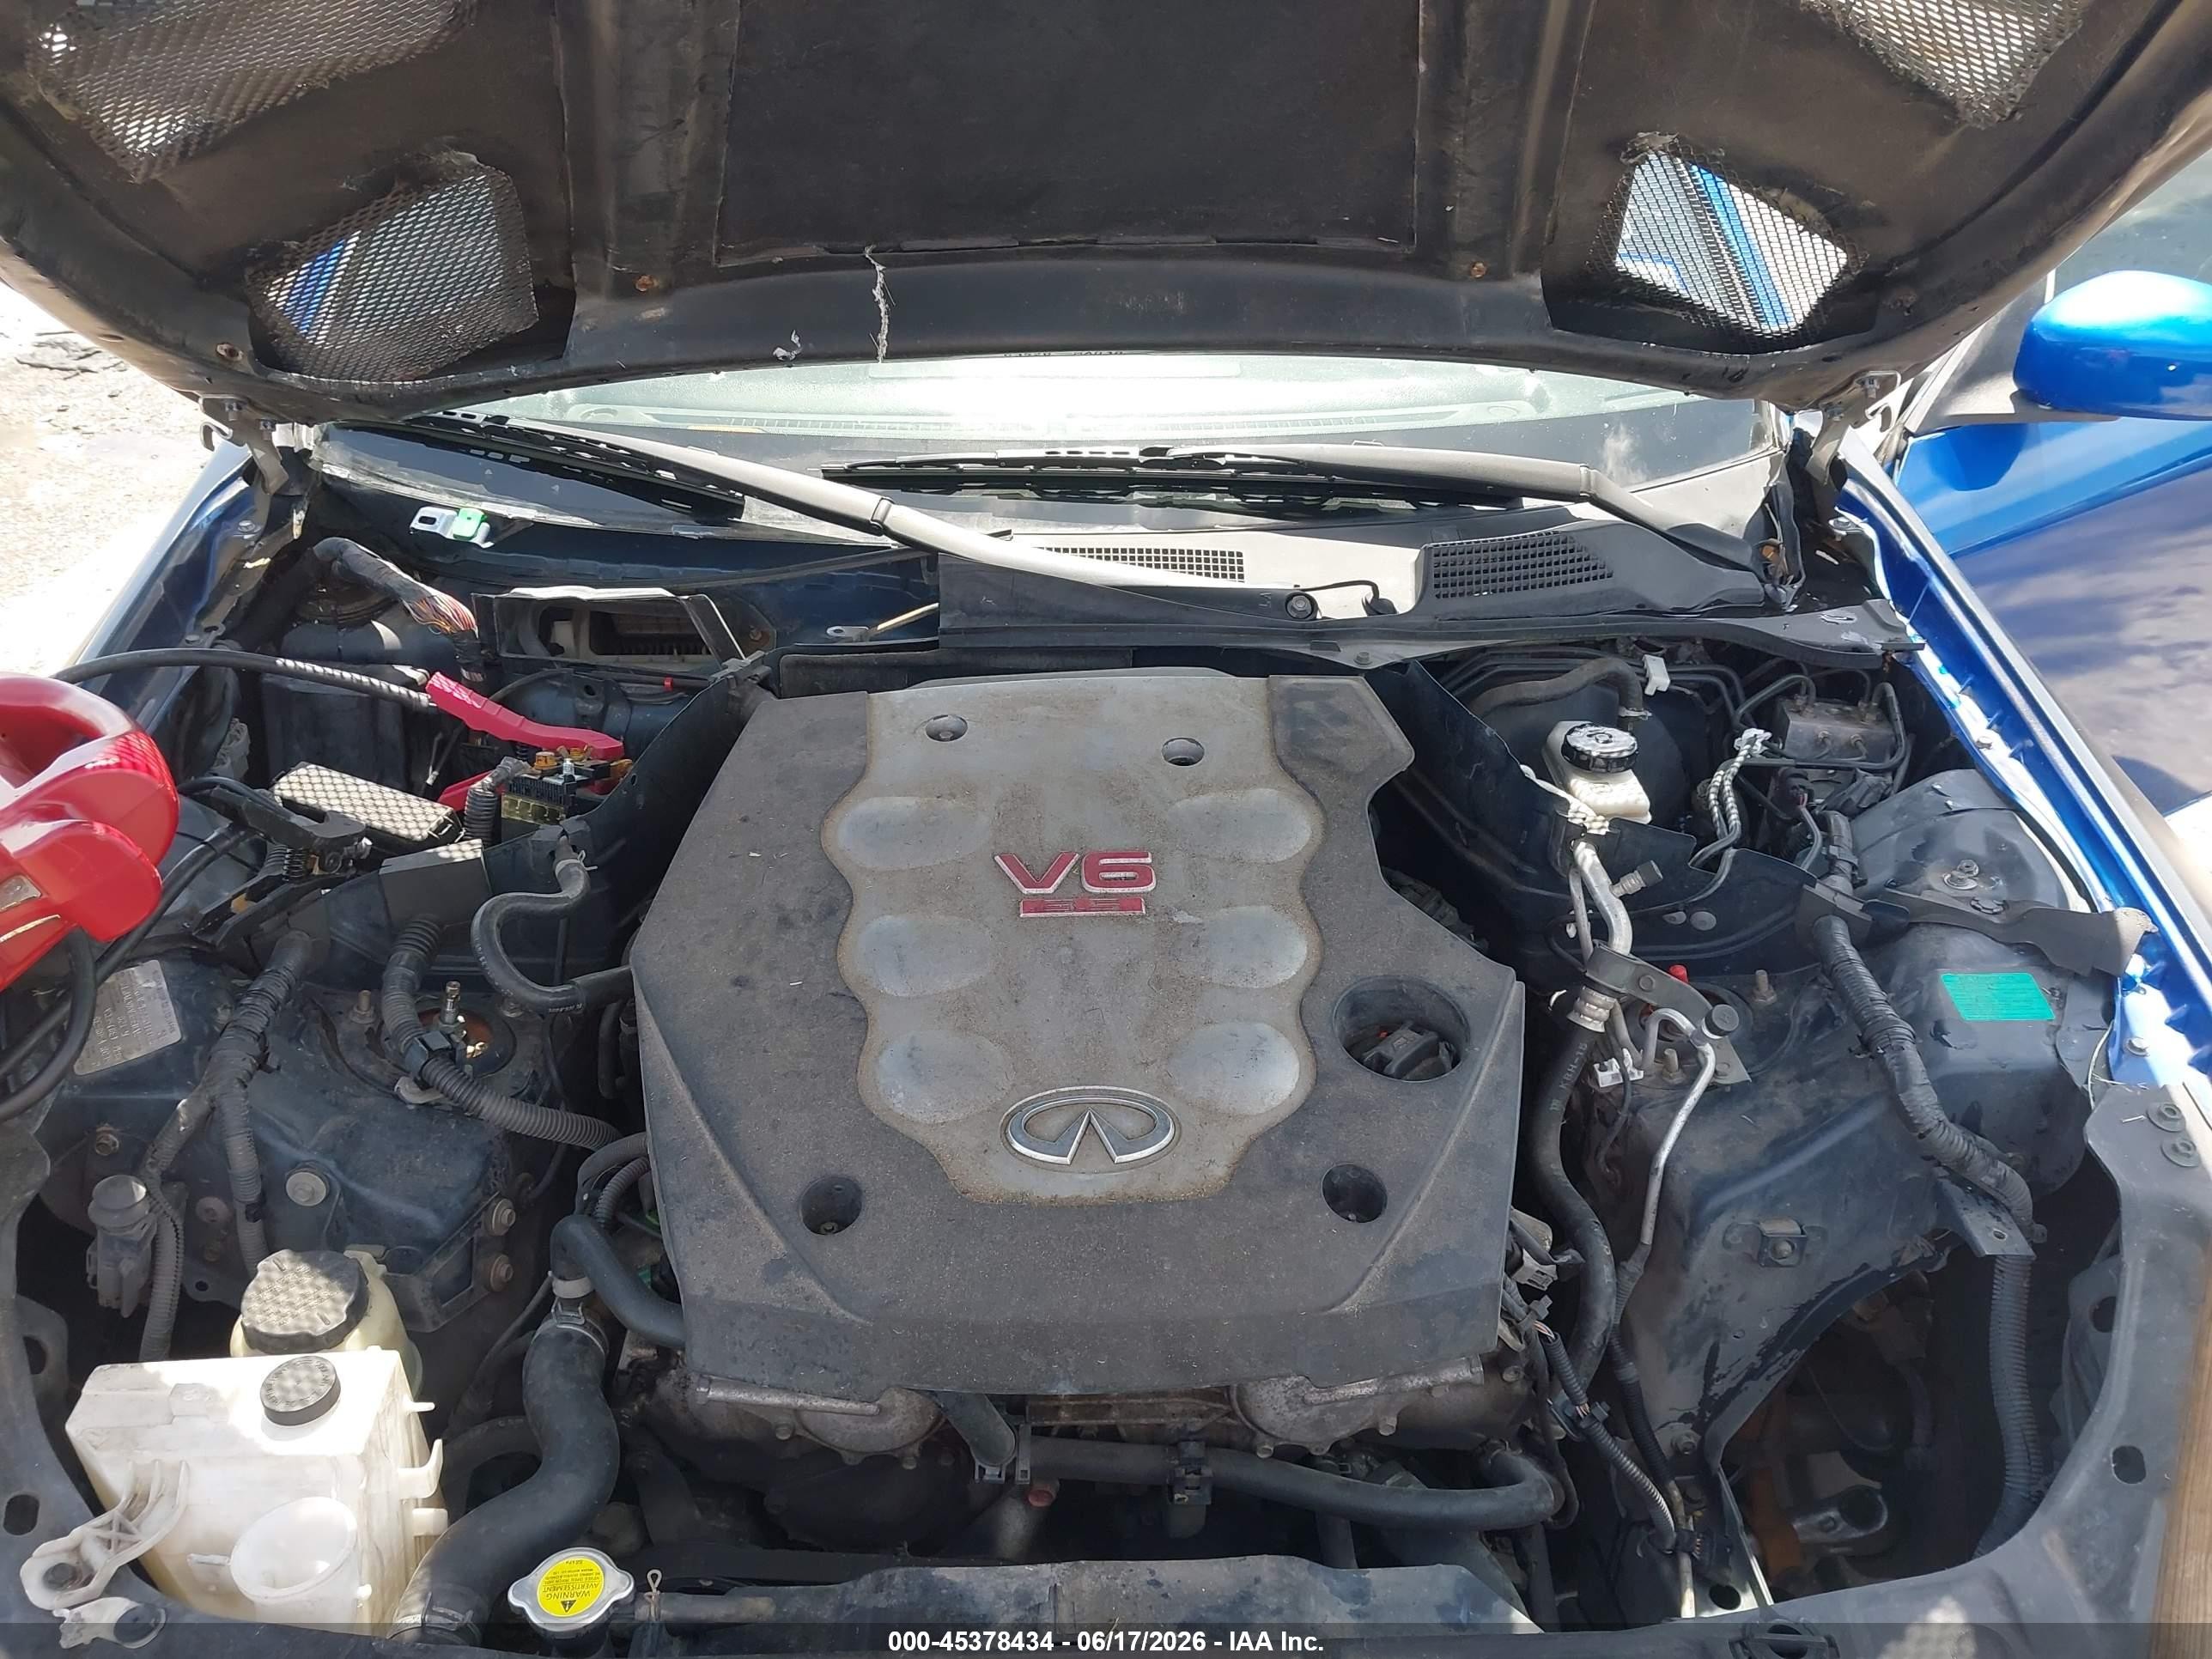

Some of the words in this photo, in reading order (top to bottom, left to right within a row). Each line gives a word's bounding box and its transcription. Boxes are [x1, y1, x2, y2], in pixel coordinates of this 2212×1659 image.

[994, 850, 1158, 895] V6
[543, 1583, 599, 1593] AVERTISSEMENT
[546, 1590, 591, 1601] WARNING
